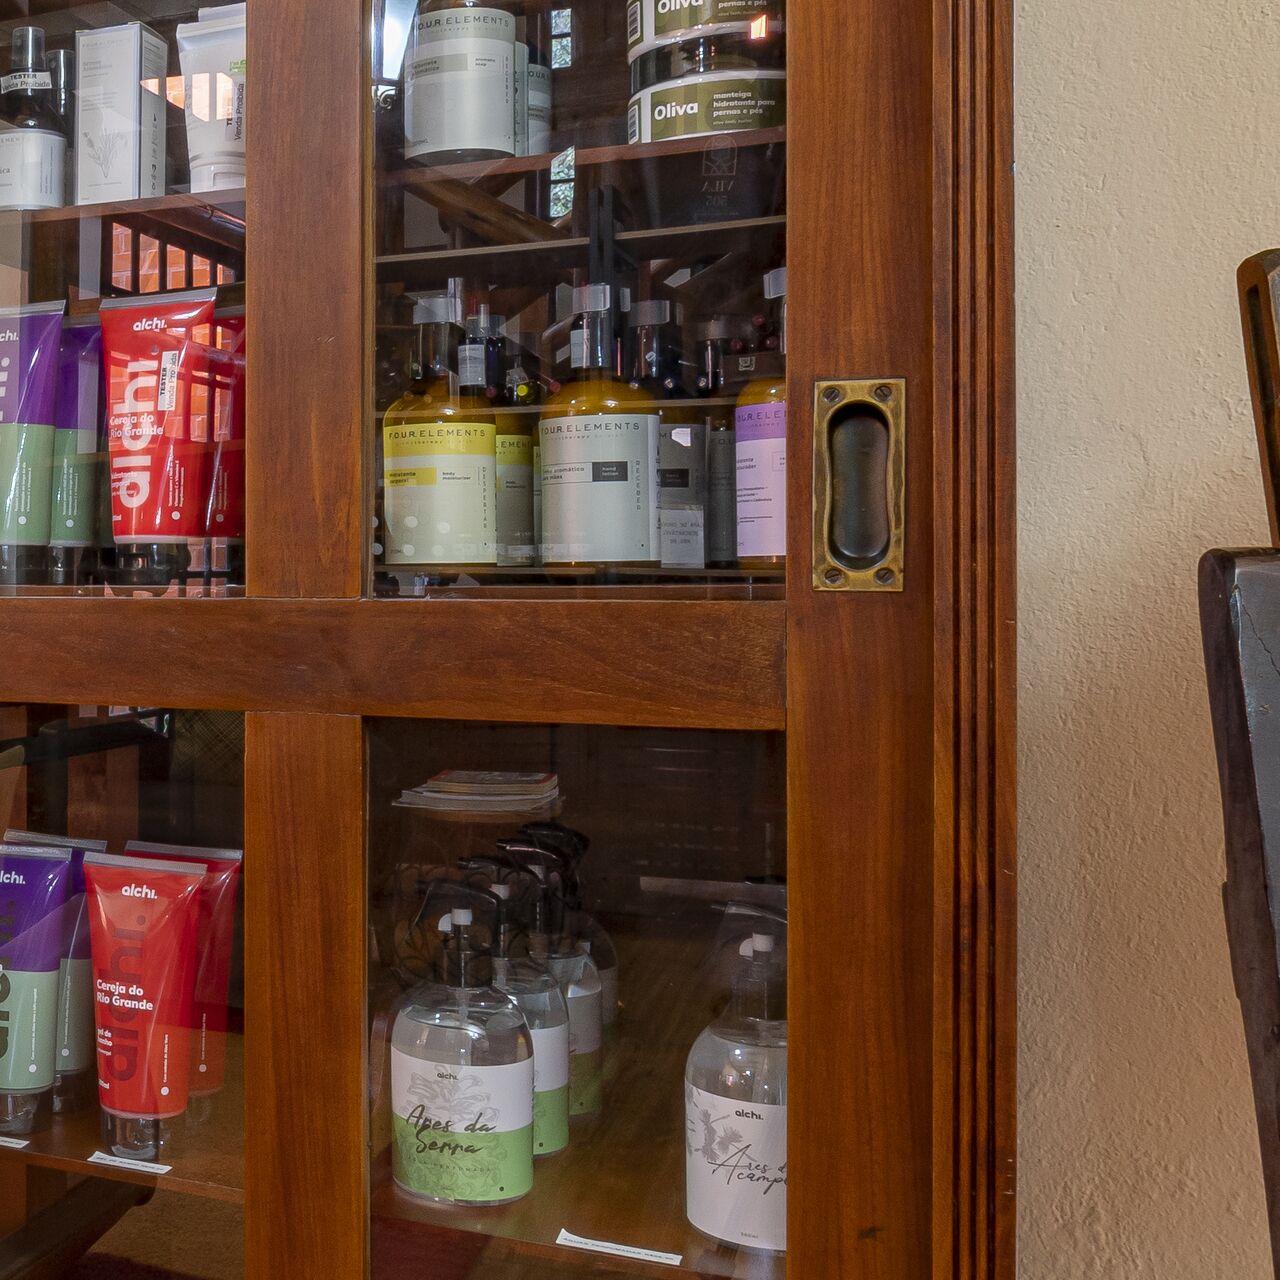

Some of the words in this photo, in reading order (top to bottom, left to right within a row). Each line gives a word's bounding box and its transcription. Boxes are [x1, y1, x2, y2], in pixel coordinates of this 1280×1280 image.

[718, 0, 746, 8] pernas
[417, 18, 441, 31] OUR
[445, 15, 510, 28] ELEMENTS
[10, 73, 38, 81] TESTER
[20, 79, 52, 89] Proibida
[235, 83, 245, 115] Proibida
[713, 91, 752, 100] manteiga
[713, 98, 756, 108] hidratante
[757, 99, 776, 108] para
[654, 100, 699, 121] Oliva
[713, 108, 741, 118] pernas
[749, 106, 764, 116] pés
[234, 116, 243, 141] Venda
[159, 367, 167, 396] TESTER
[110, 414, 137, 428] Cereja
[140, 413, 155, 423] do
[566, 421, 641, 434] ELEMENTS
[124, 425, 164, 438] Grande
[419, 428, 487, 438] ELEMENTS
[121, 883, 158, 900] alchi.
[96, 978, 126, 995] Cereja
[129, 983, 144, 997] do
[96, 991, 110, 1005] Rio
[112, 995, 154, 1012] Grande
[406, 1104, 454, 1132] Ares
[464, 1112, 497, 1134] da
[735, 1109, 764, 1121] alchi.
[415, 1124, 484, 1156] Serra
[707, 1143, 773, 1185] Ares
